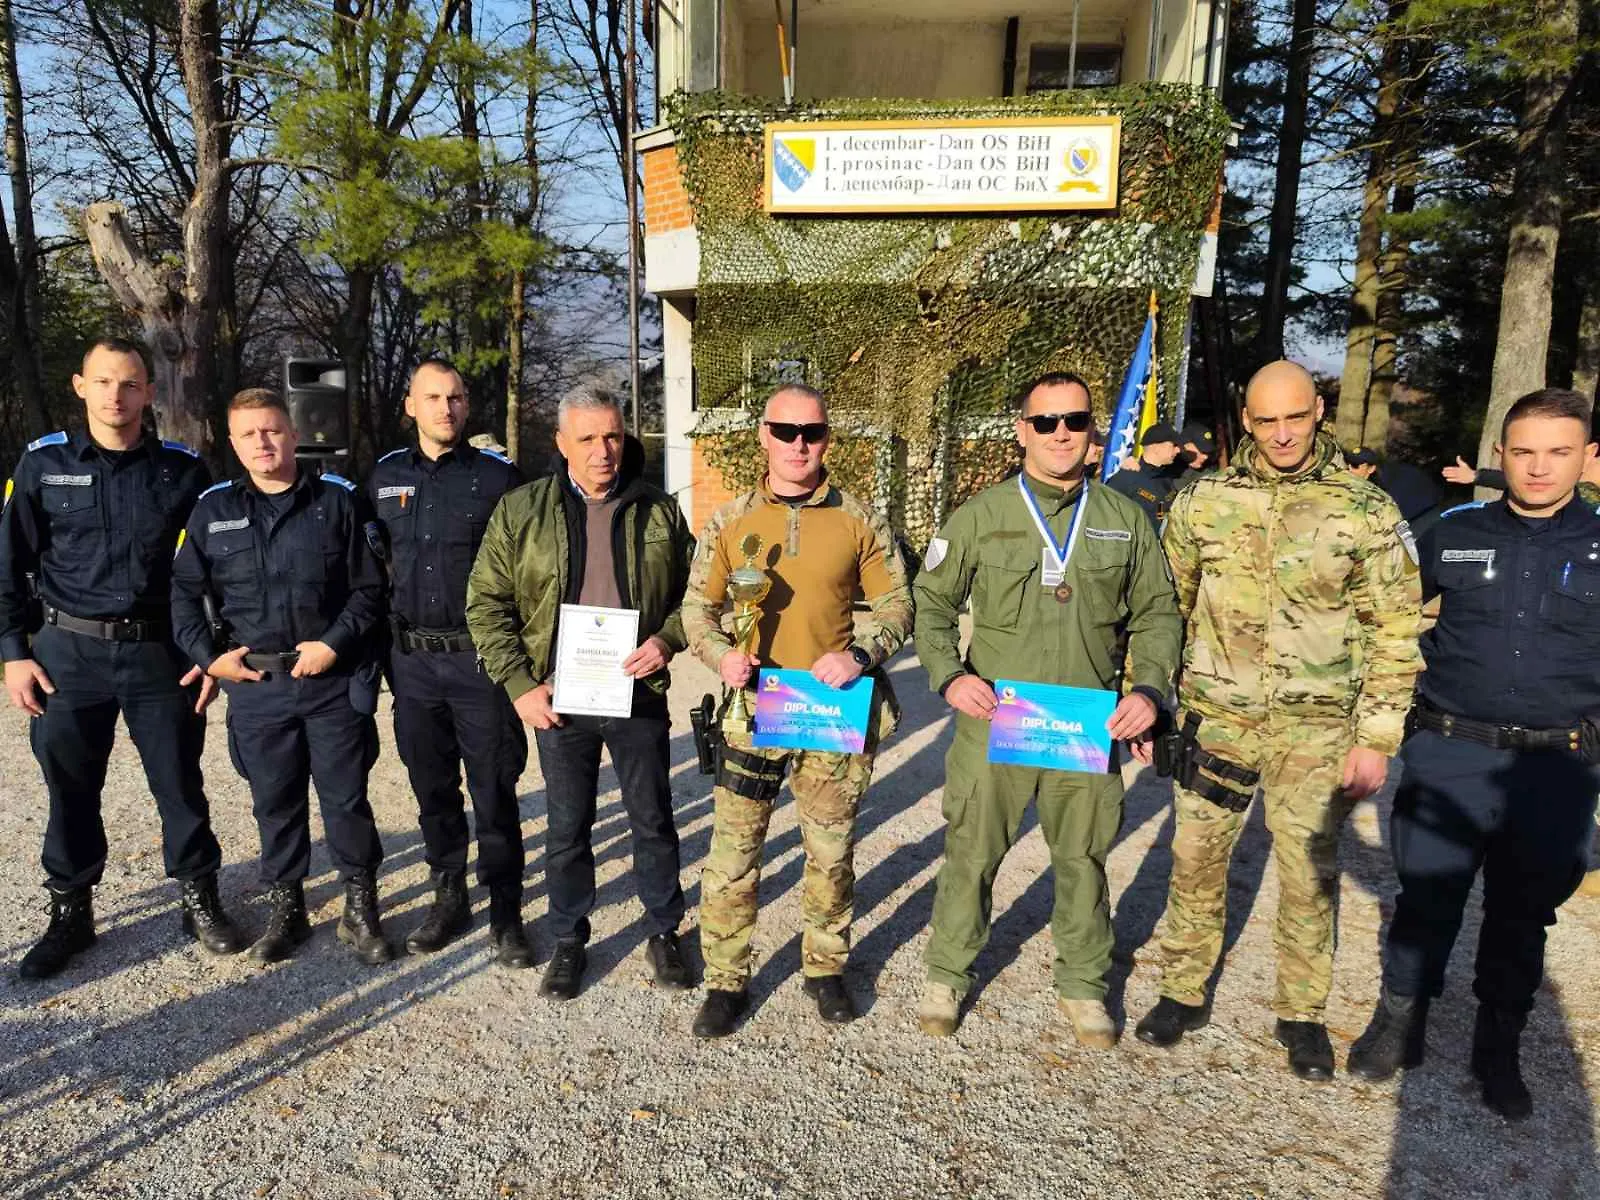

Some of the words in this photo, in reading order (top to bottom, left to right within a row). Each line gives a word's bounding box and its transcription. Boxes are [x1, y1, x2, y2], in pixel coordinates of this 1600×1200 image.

[825, 136, 837, 151] 1.
[981, 134, 1009, 151] OS
[1017, 135, 1051, 151] BiH
[825, 156, 837, 171] 1.
[980, 155, 1007, 171] OS
[1016, 155, 1050, 171] BiH
[784, 702, 841, 716] DIPLOMA
[1022, 717, 1083, 733] DIPLOMA
